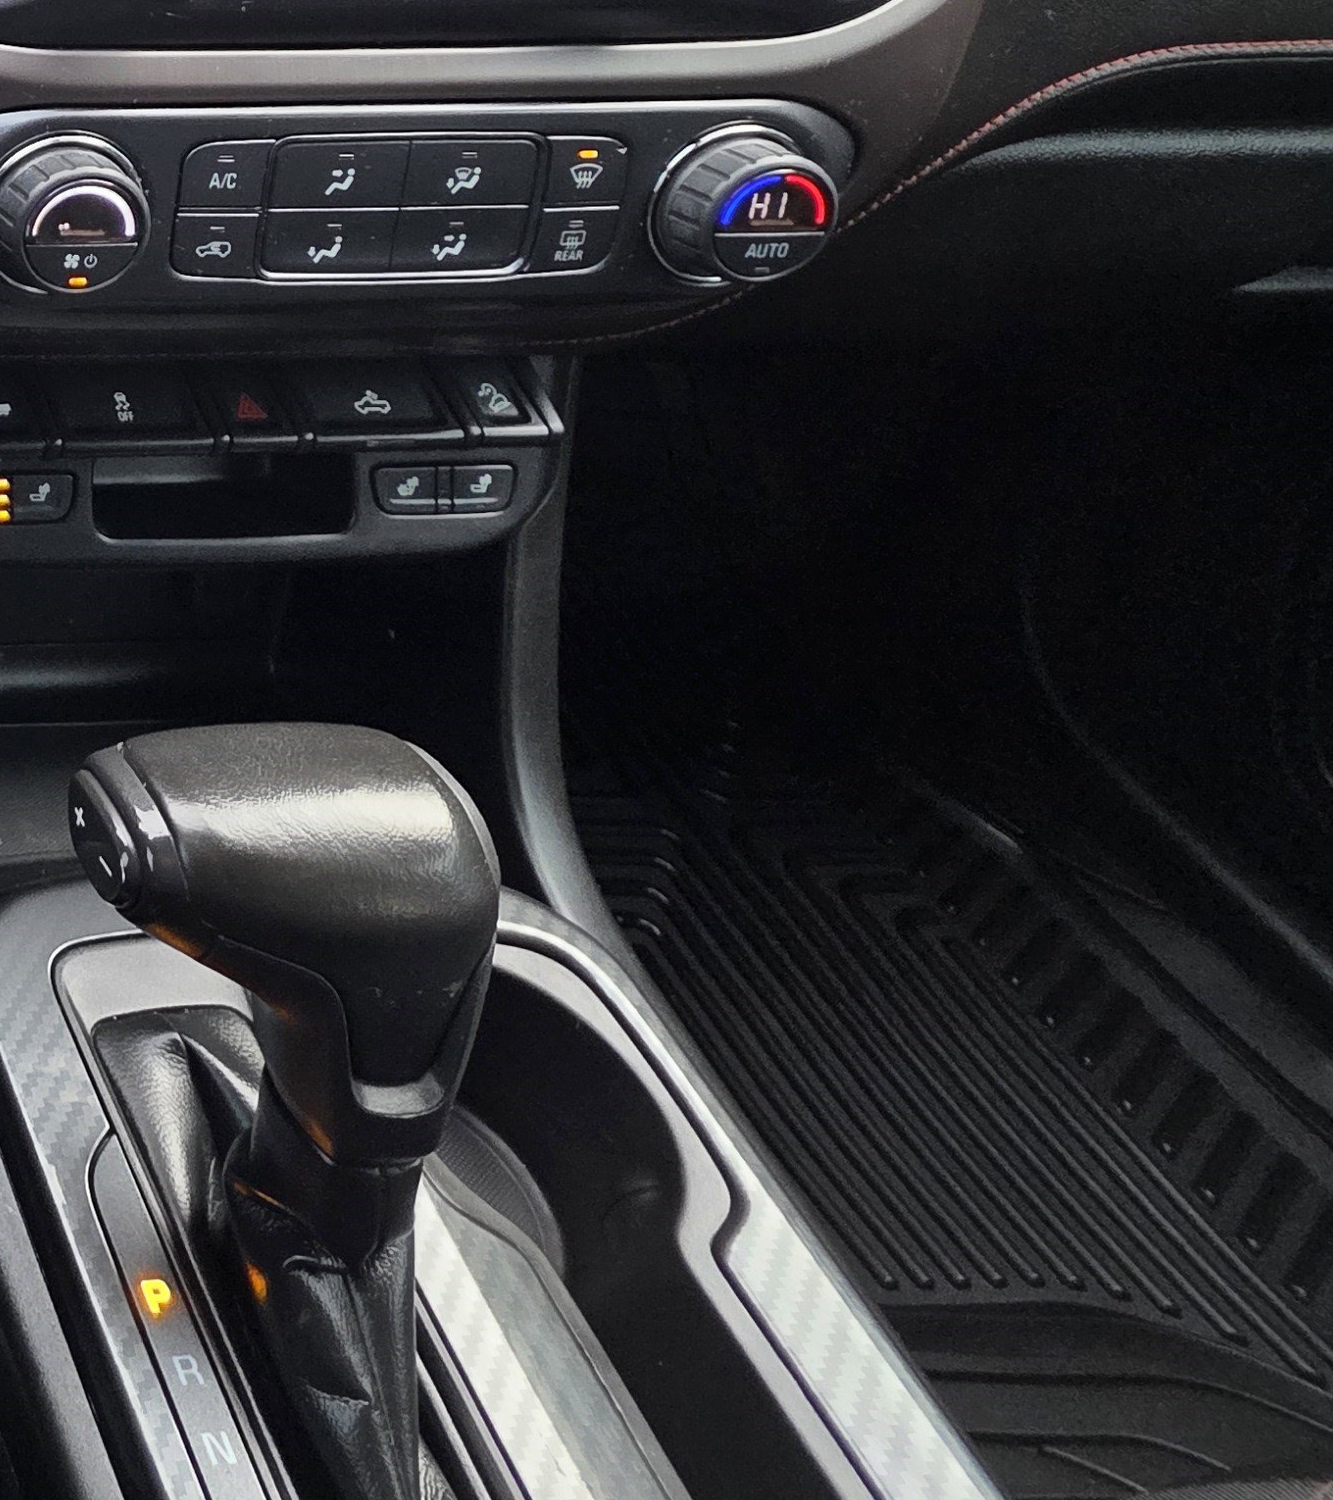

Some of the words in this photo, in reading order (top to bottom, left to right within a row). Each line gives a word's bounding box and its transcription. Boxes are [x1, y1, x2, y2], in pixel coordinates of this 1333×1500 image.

[209, 172, 238, 189] A/C
[554, 250, 583, 261] REAR
[744, 242, 789, 258] AUTO
[140, 1278, 171, 1314] P
[171, 1354, 205, 1387] R
[199, 1430, 239, 1465] N
